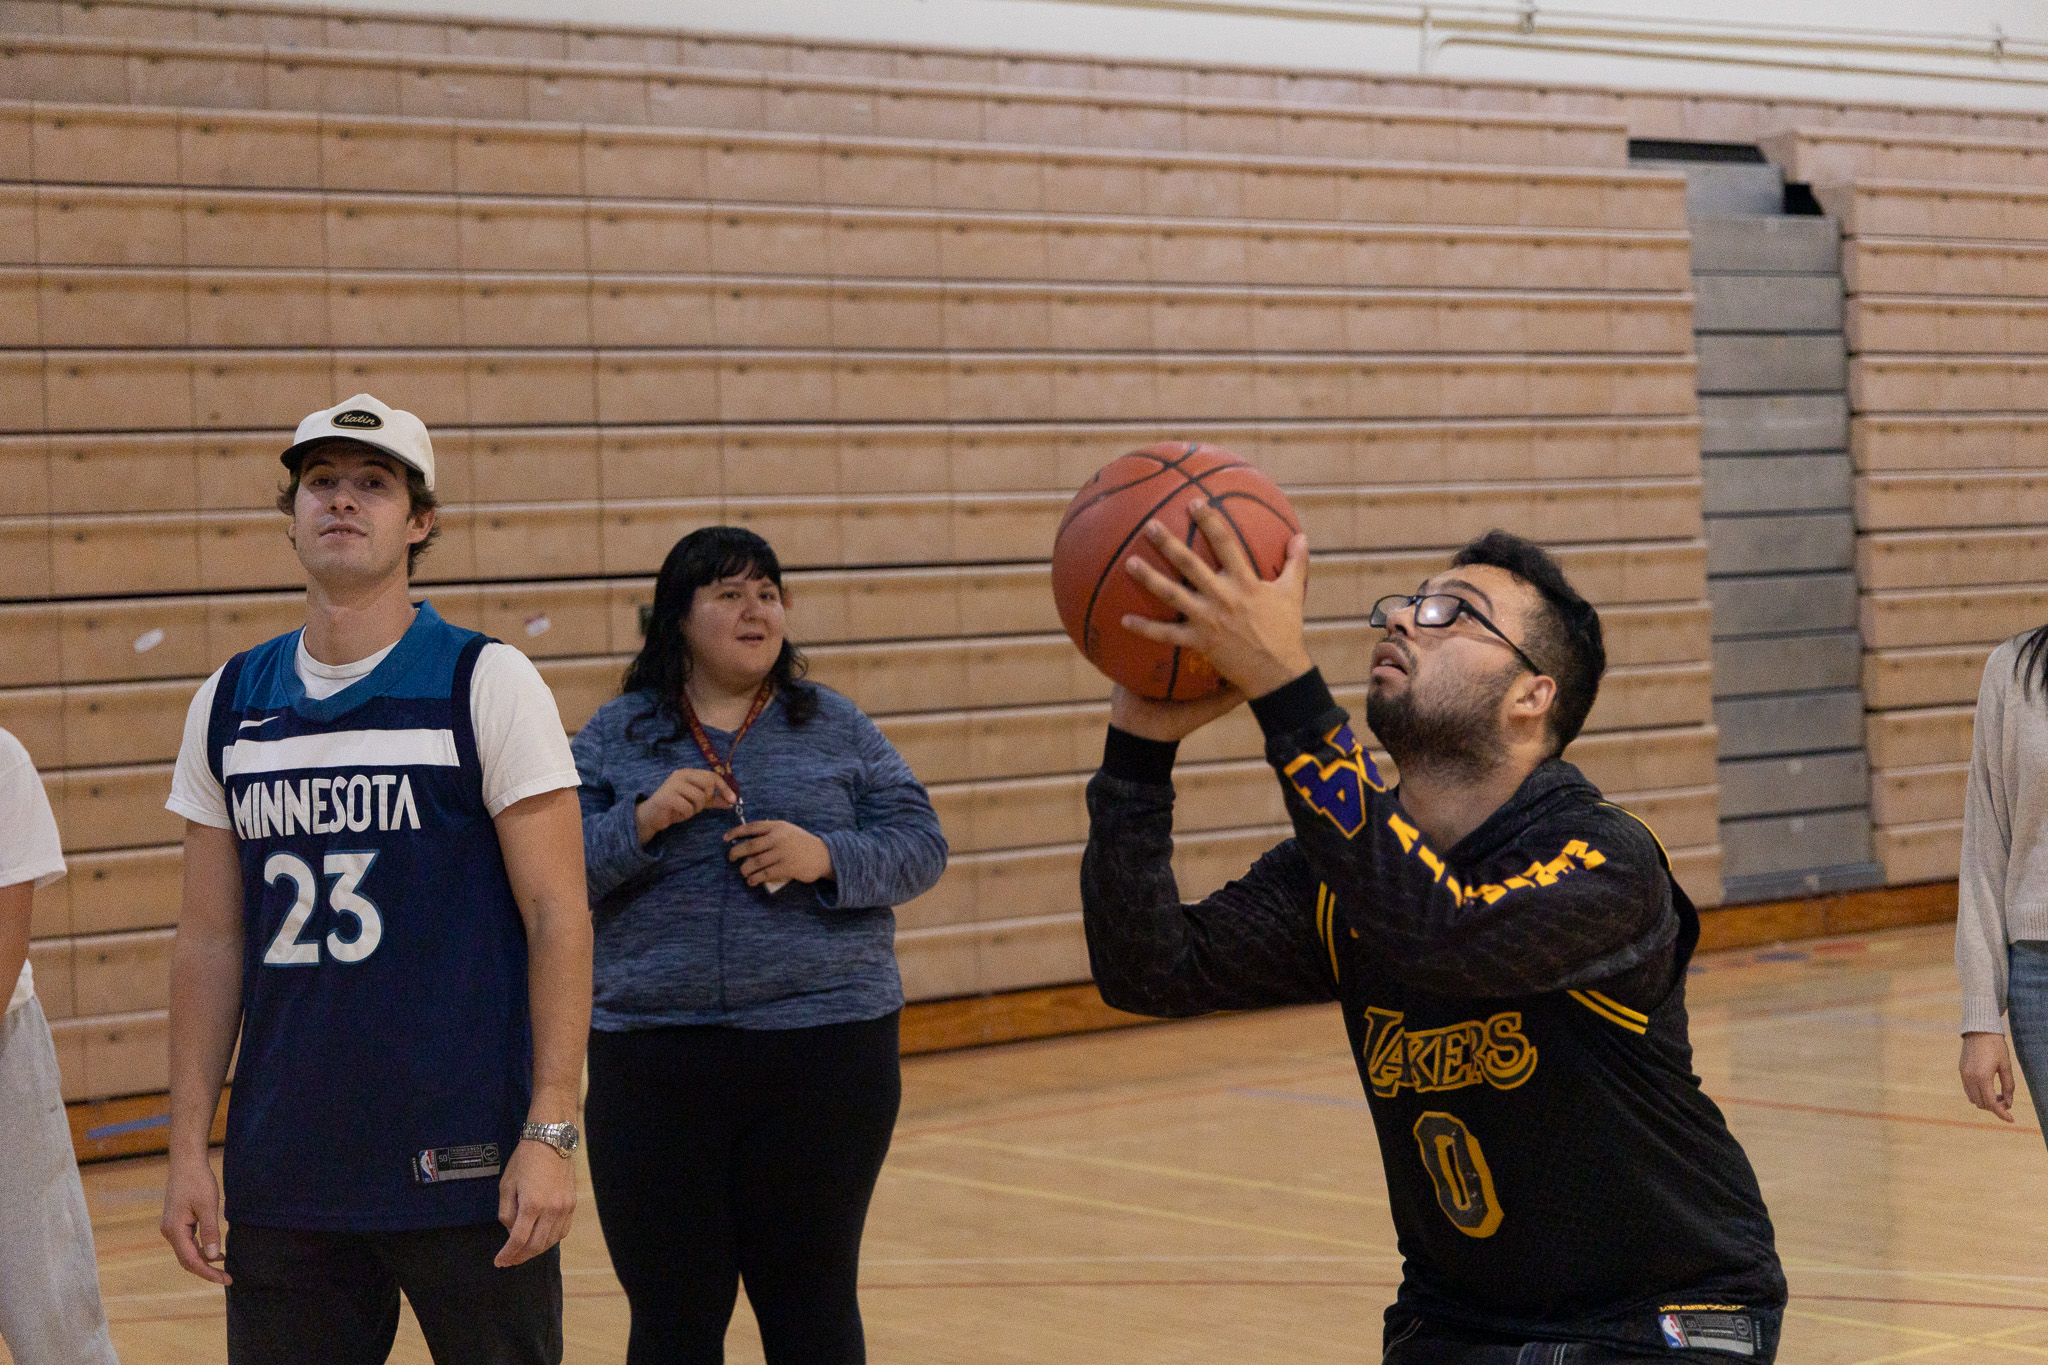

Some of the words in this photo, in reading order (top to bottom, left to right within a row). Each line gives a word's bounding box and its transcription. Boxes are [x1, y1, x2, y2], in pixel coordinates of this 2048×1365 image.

[339, 413, 375, 425] Katin
[232, 774, 421, 840] MINNESOTA
[262, 849, 384, 967] 23
[1364, 1006, 1538, 1097] LAKERS
[438, 1154, 447, 1162] 50
[1413, 1111, 1504, 1238] 0
